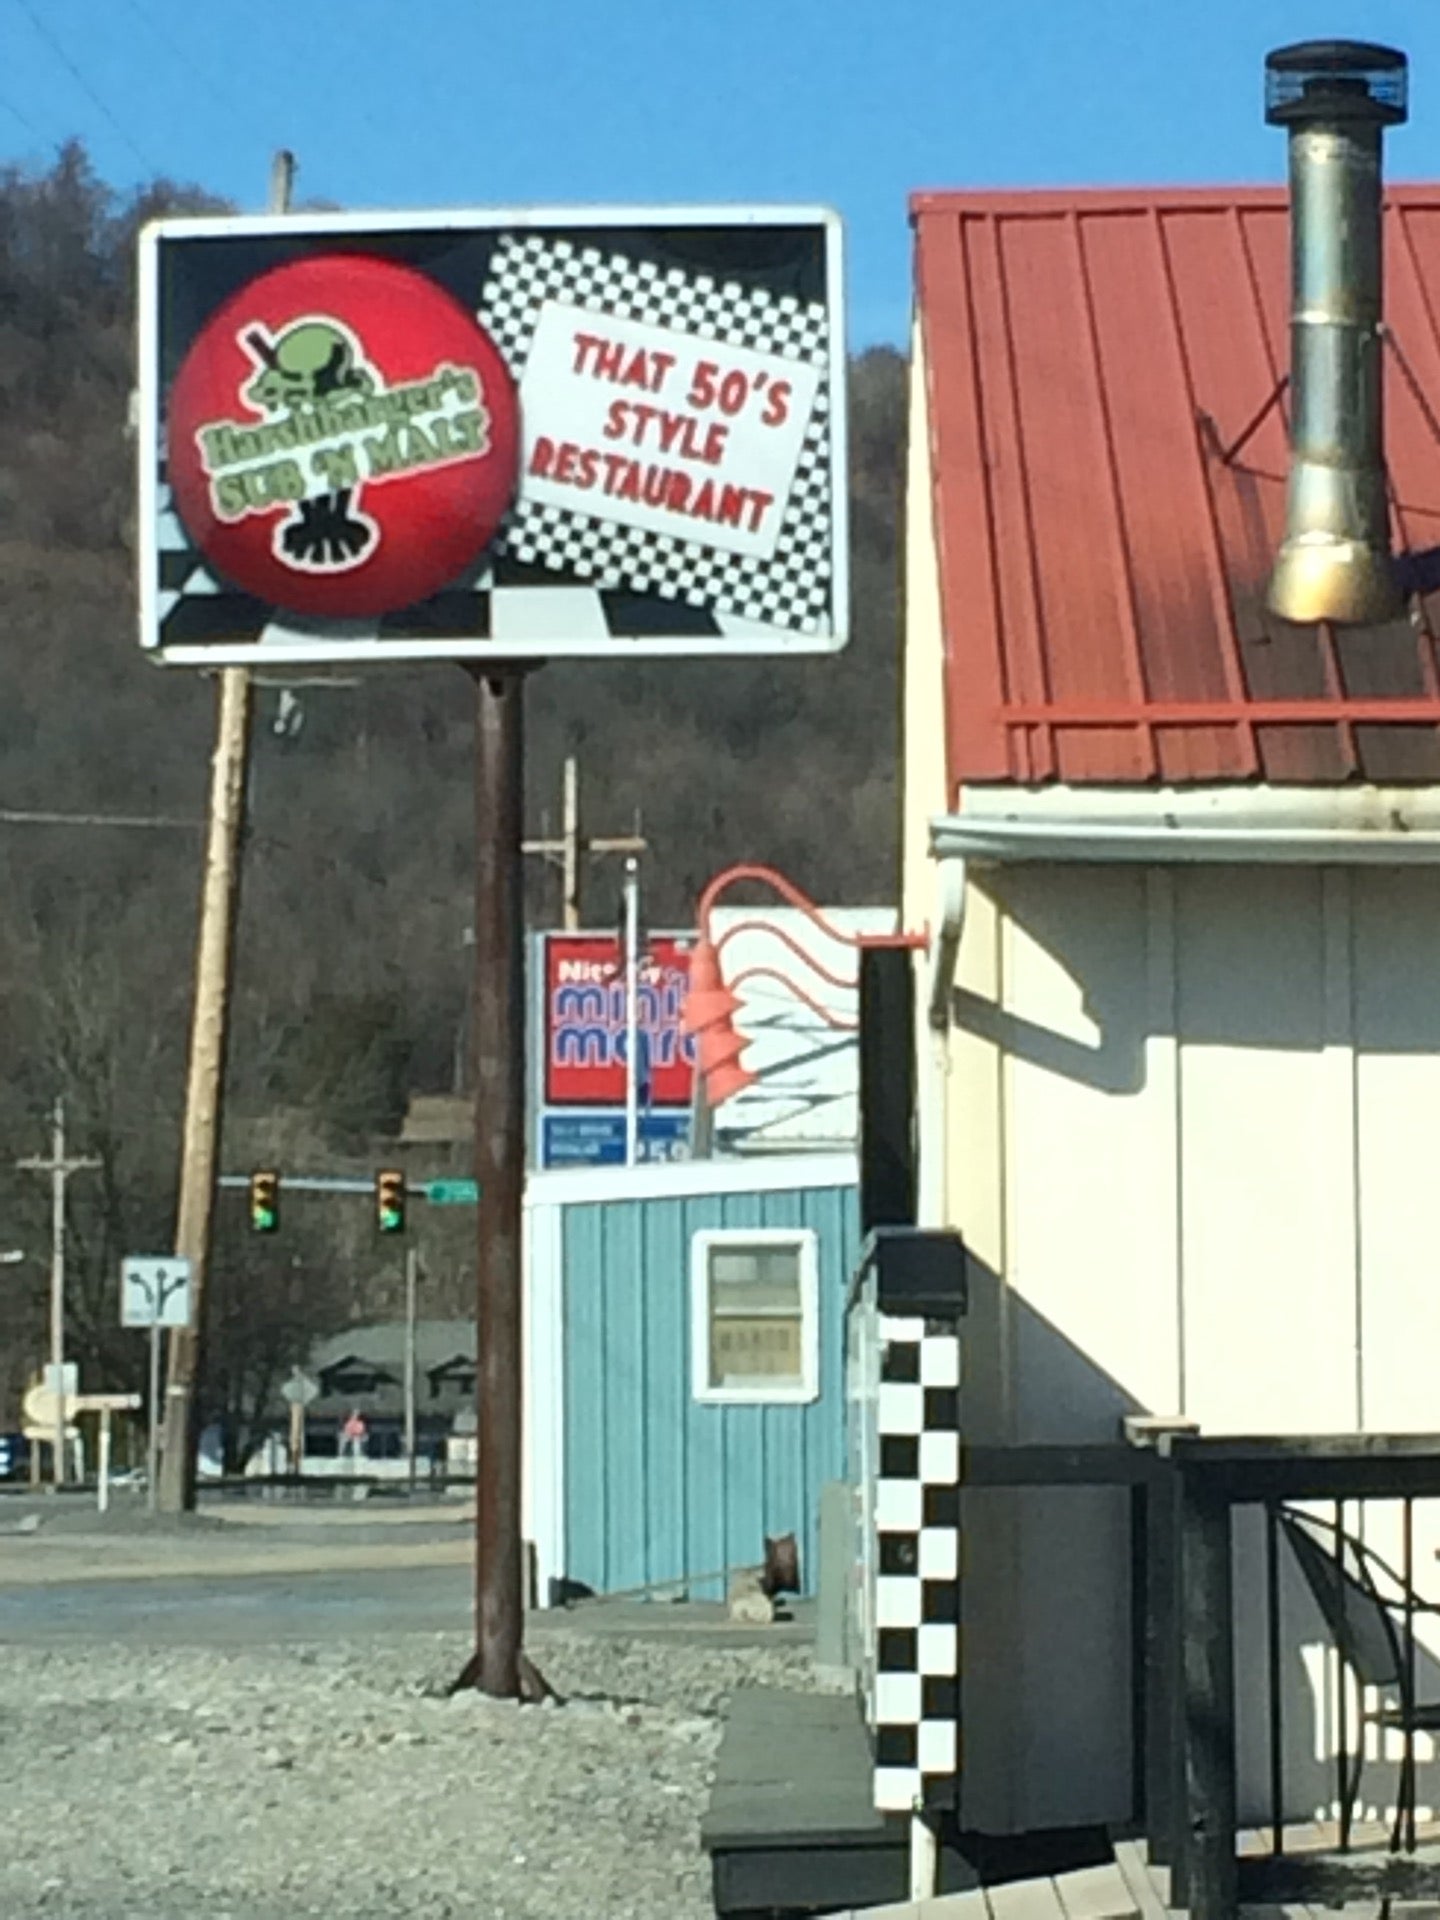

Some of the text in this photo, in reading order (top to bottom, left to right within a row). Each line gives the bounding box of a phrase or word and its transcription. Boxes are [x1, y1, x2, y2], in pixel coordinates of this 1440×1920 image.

[573, 332, 792, 427] THAT 50'S
[215, 460, 305, 515] SUB
[362, 410, 485, 475] MALT
[603, 399, 729, 465] STYLE
[528, 436, 774, 532] RESTAURANT
